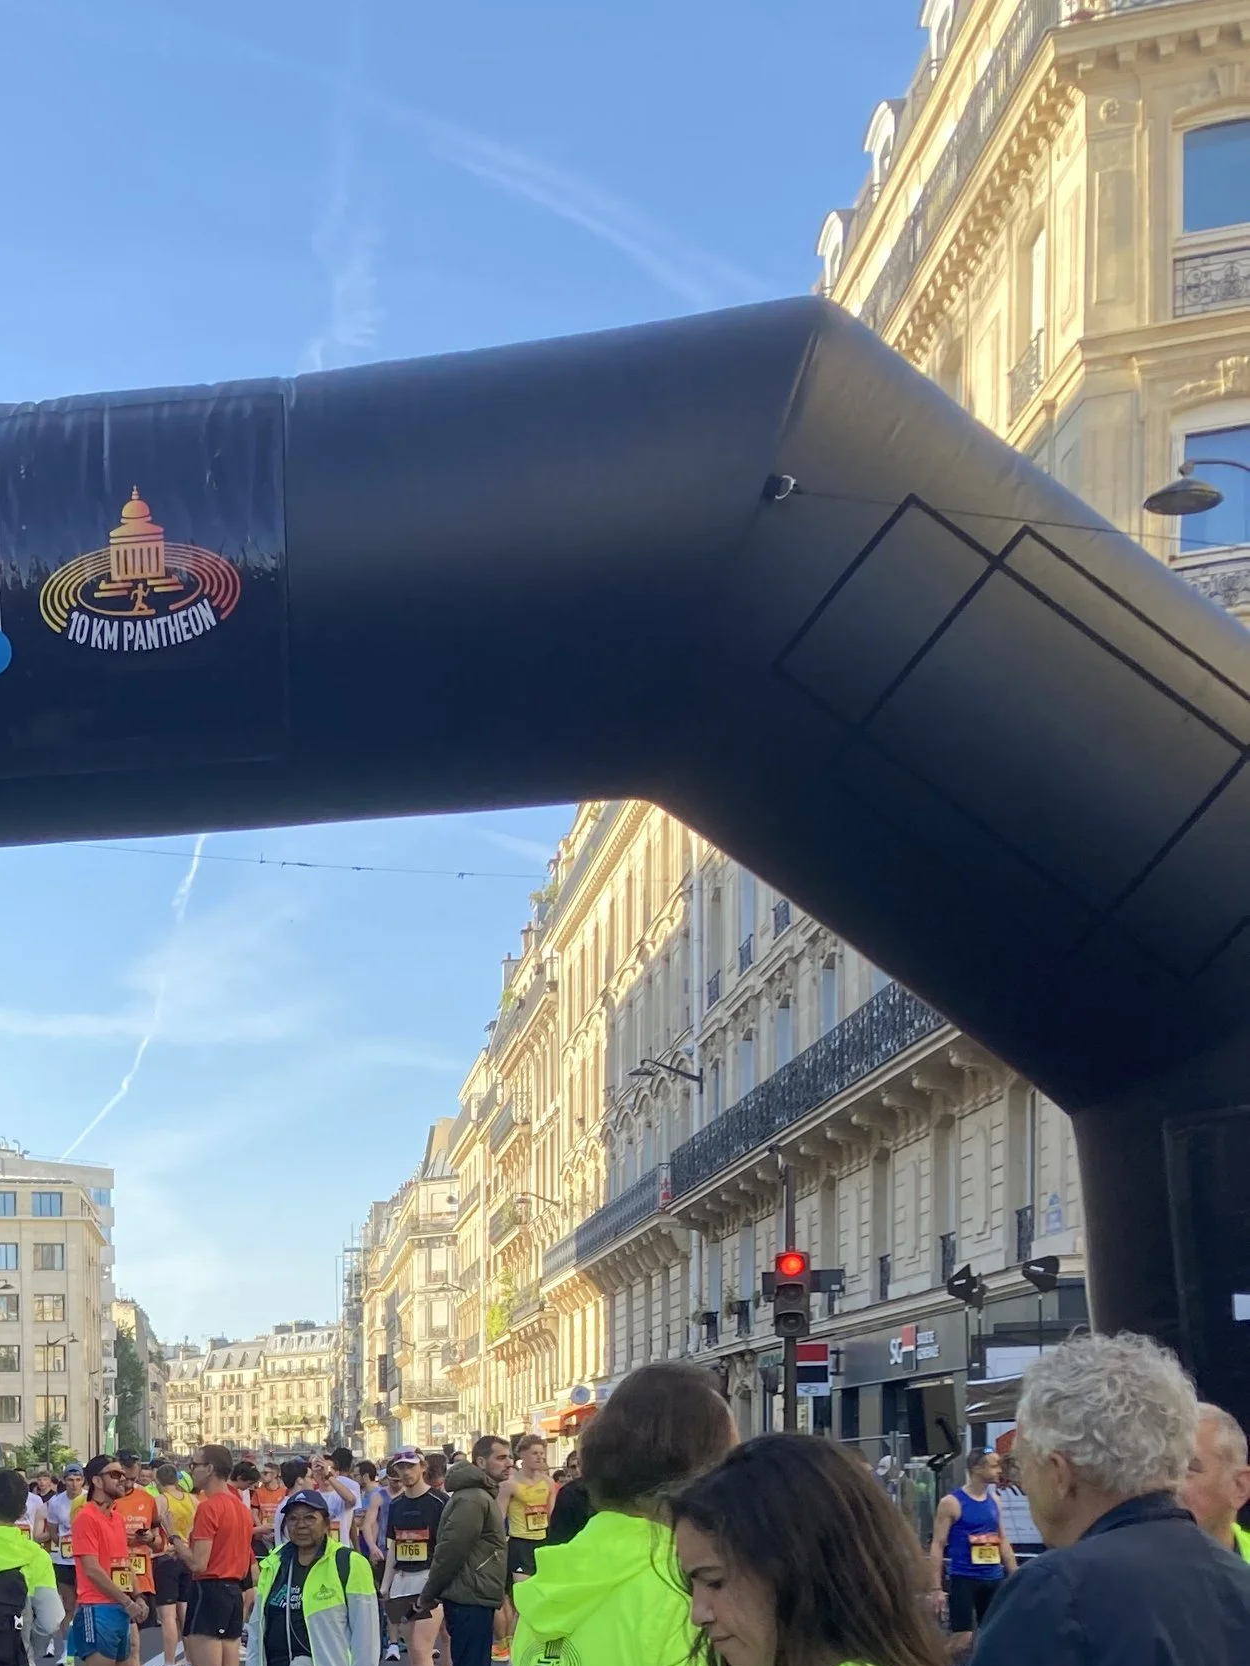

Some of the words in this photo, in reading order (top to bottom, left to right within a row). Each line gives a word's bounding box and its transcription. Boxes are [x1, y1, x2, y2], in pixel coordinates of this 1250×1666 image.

[67, 611, 90, 644] 10
[90, 617, 119, 651] KM
[123, 598, 217, 652] PANTHEON
[400, 1544, 420, 1557] 1766
